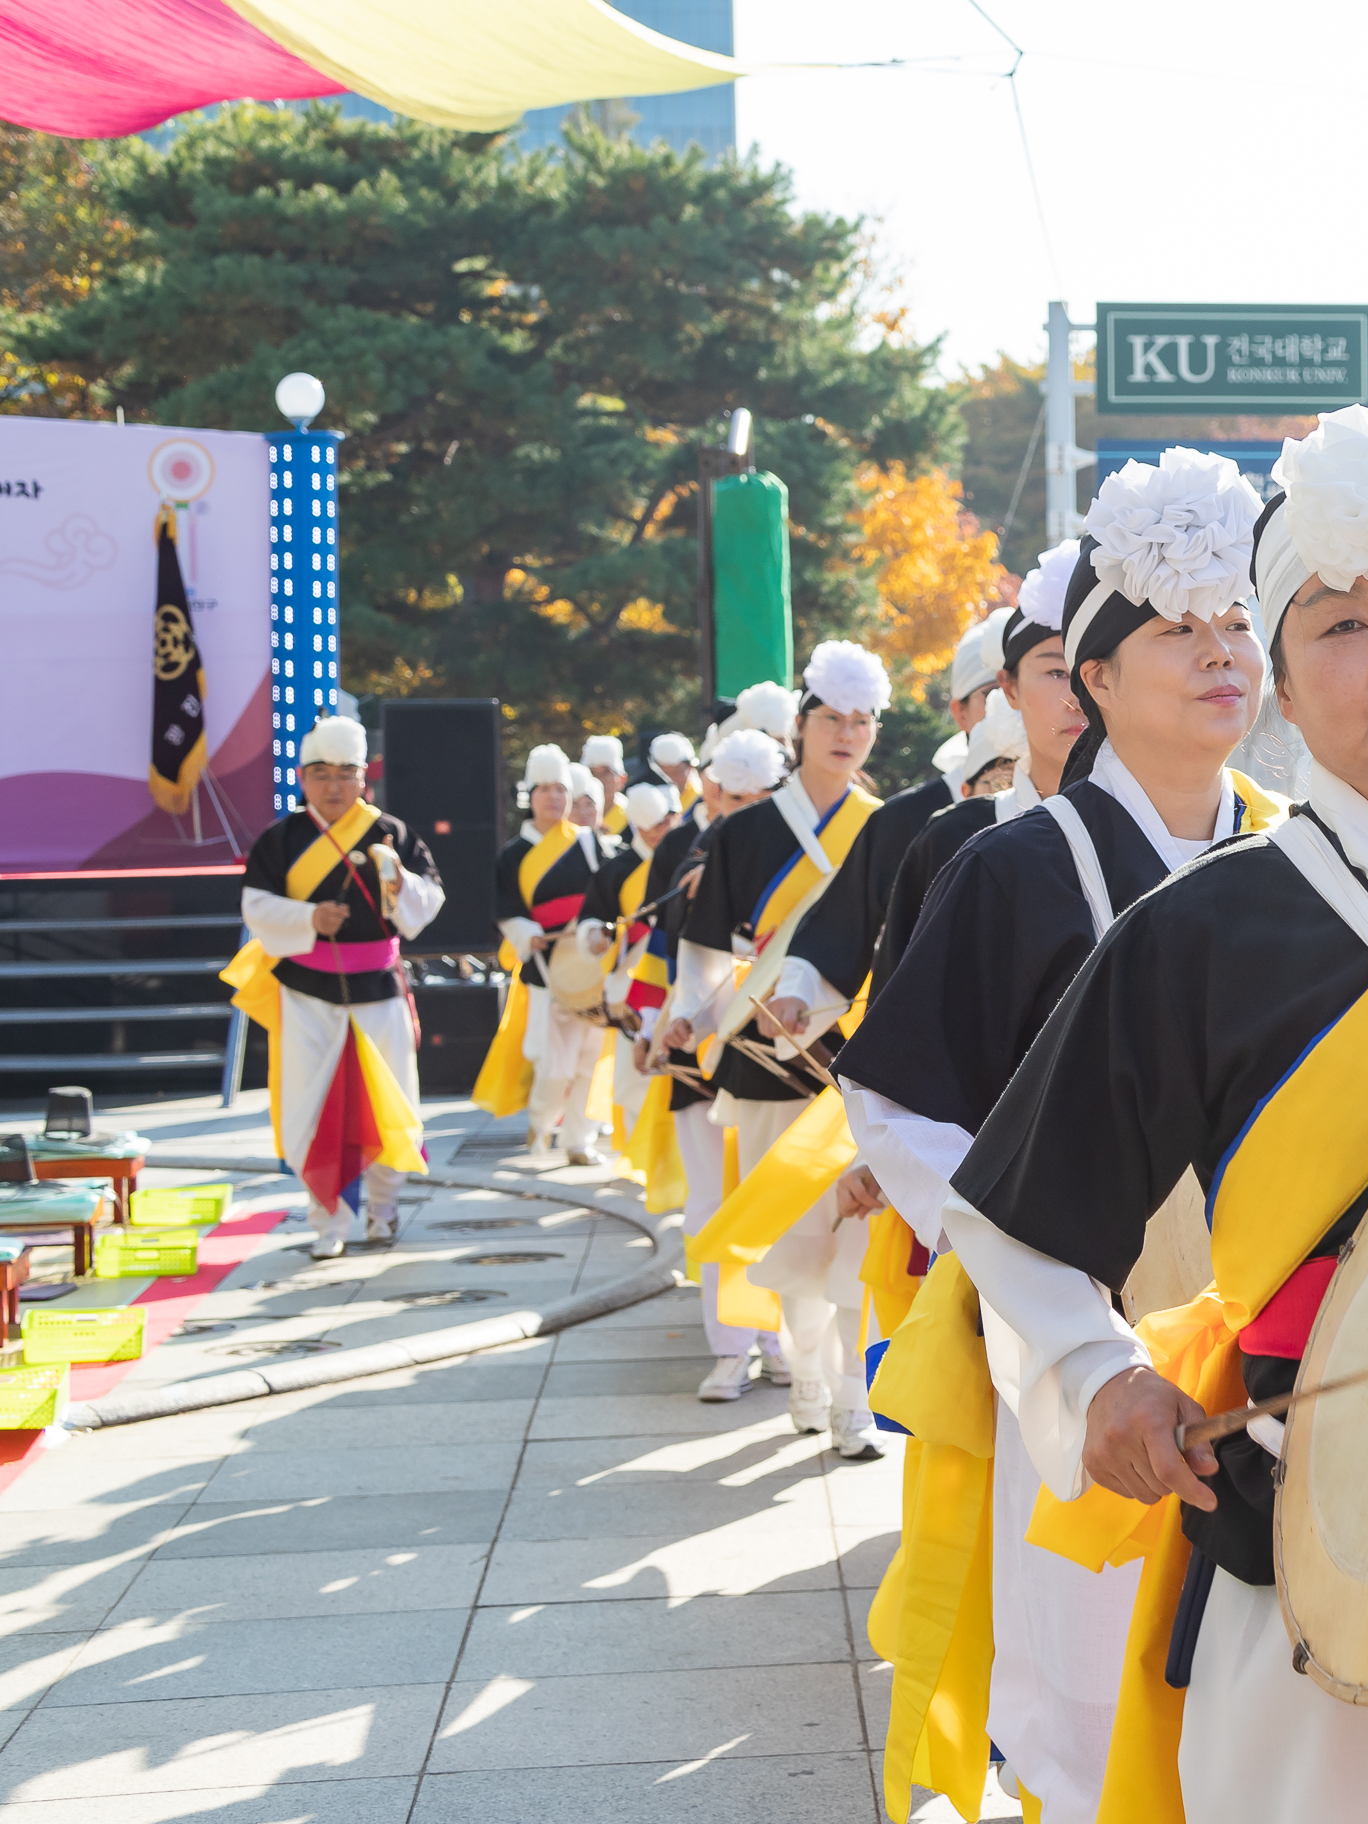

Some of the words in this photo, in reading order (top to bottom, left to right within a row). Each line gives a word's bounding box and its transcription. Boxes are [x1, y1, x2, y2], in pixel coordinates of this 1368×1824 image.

[1126, 334, 1221, 383] KU
[1225, 333, 1350, 365] 건국대학교
[1226, 366, 1301, 384] KONKUK
